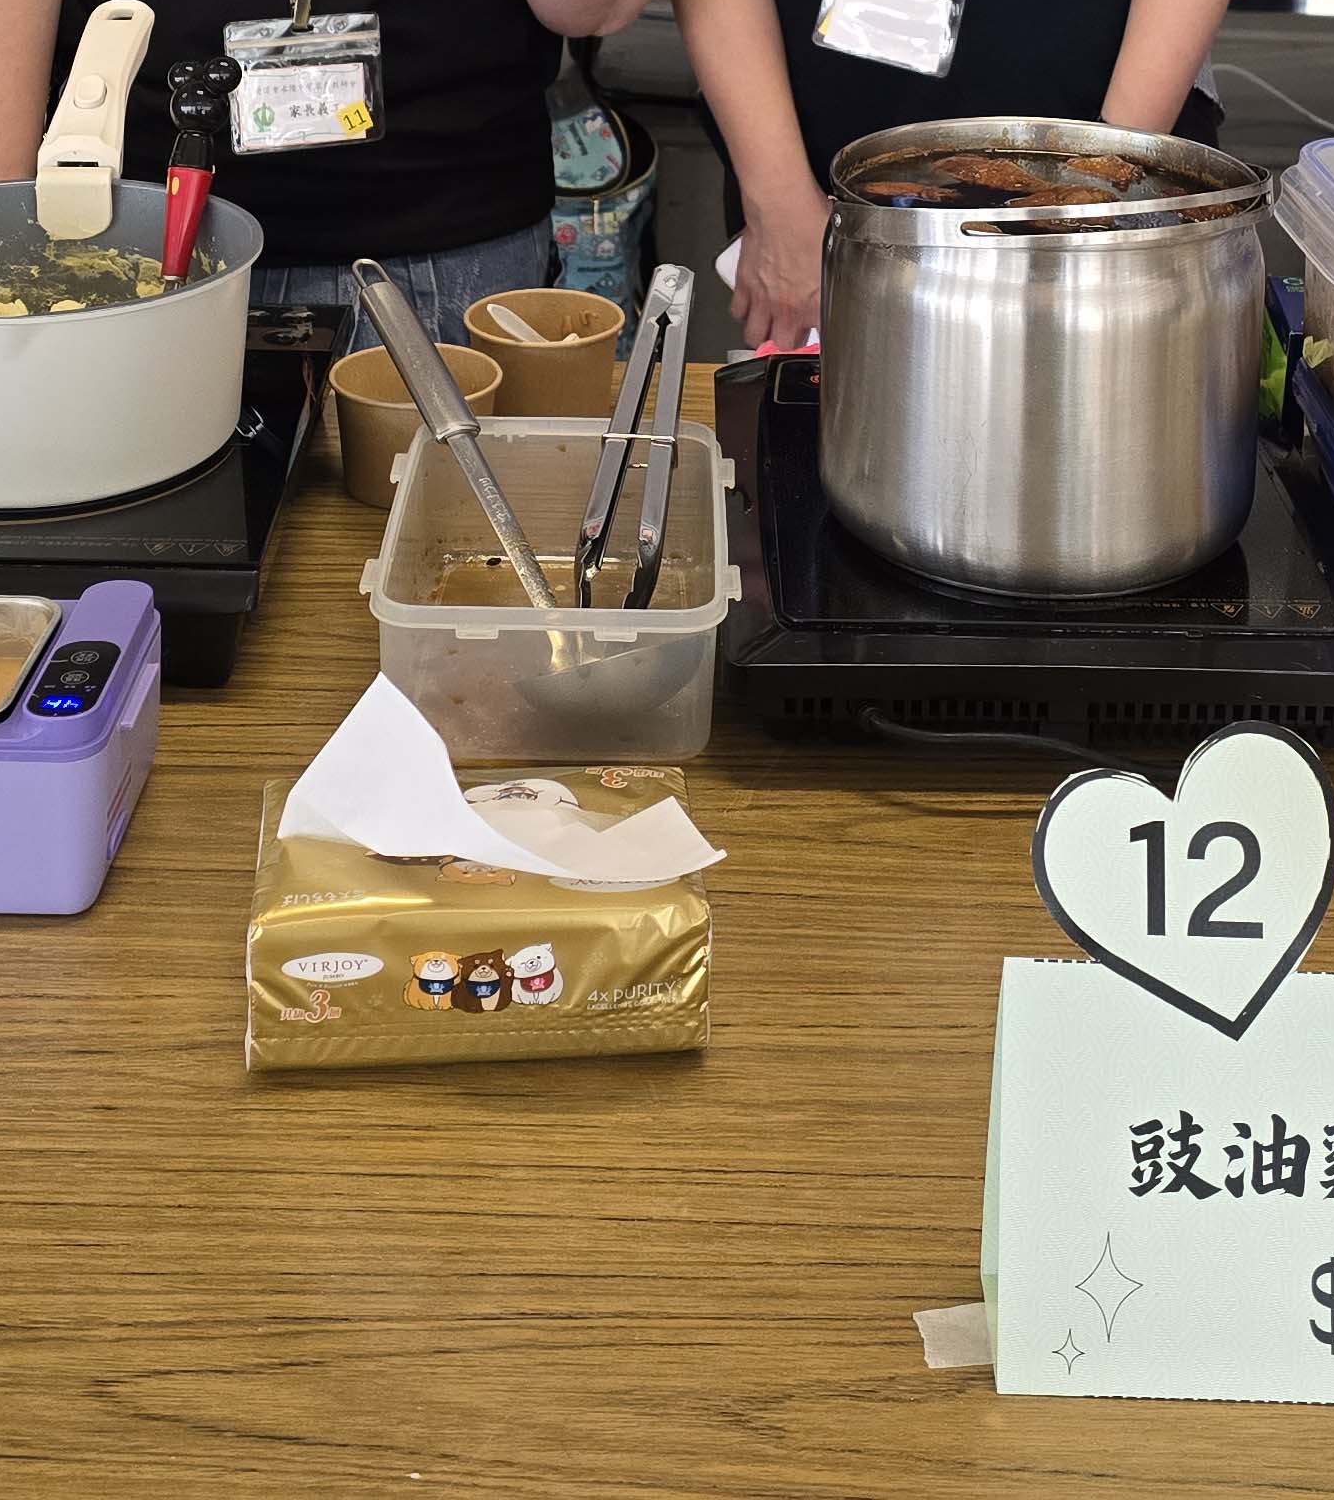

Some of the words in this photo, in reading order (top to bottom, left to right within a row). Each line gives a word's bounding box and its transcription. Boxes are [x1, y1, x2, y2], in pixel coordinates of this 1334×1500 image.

[343, 108, 367, 131] 11
[1129, 819, 1264, 940] 12
[613, 981, 677, 1002] PURITY
